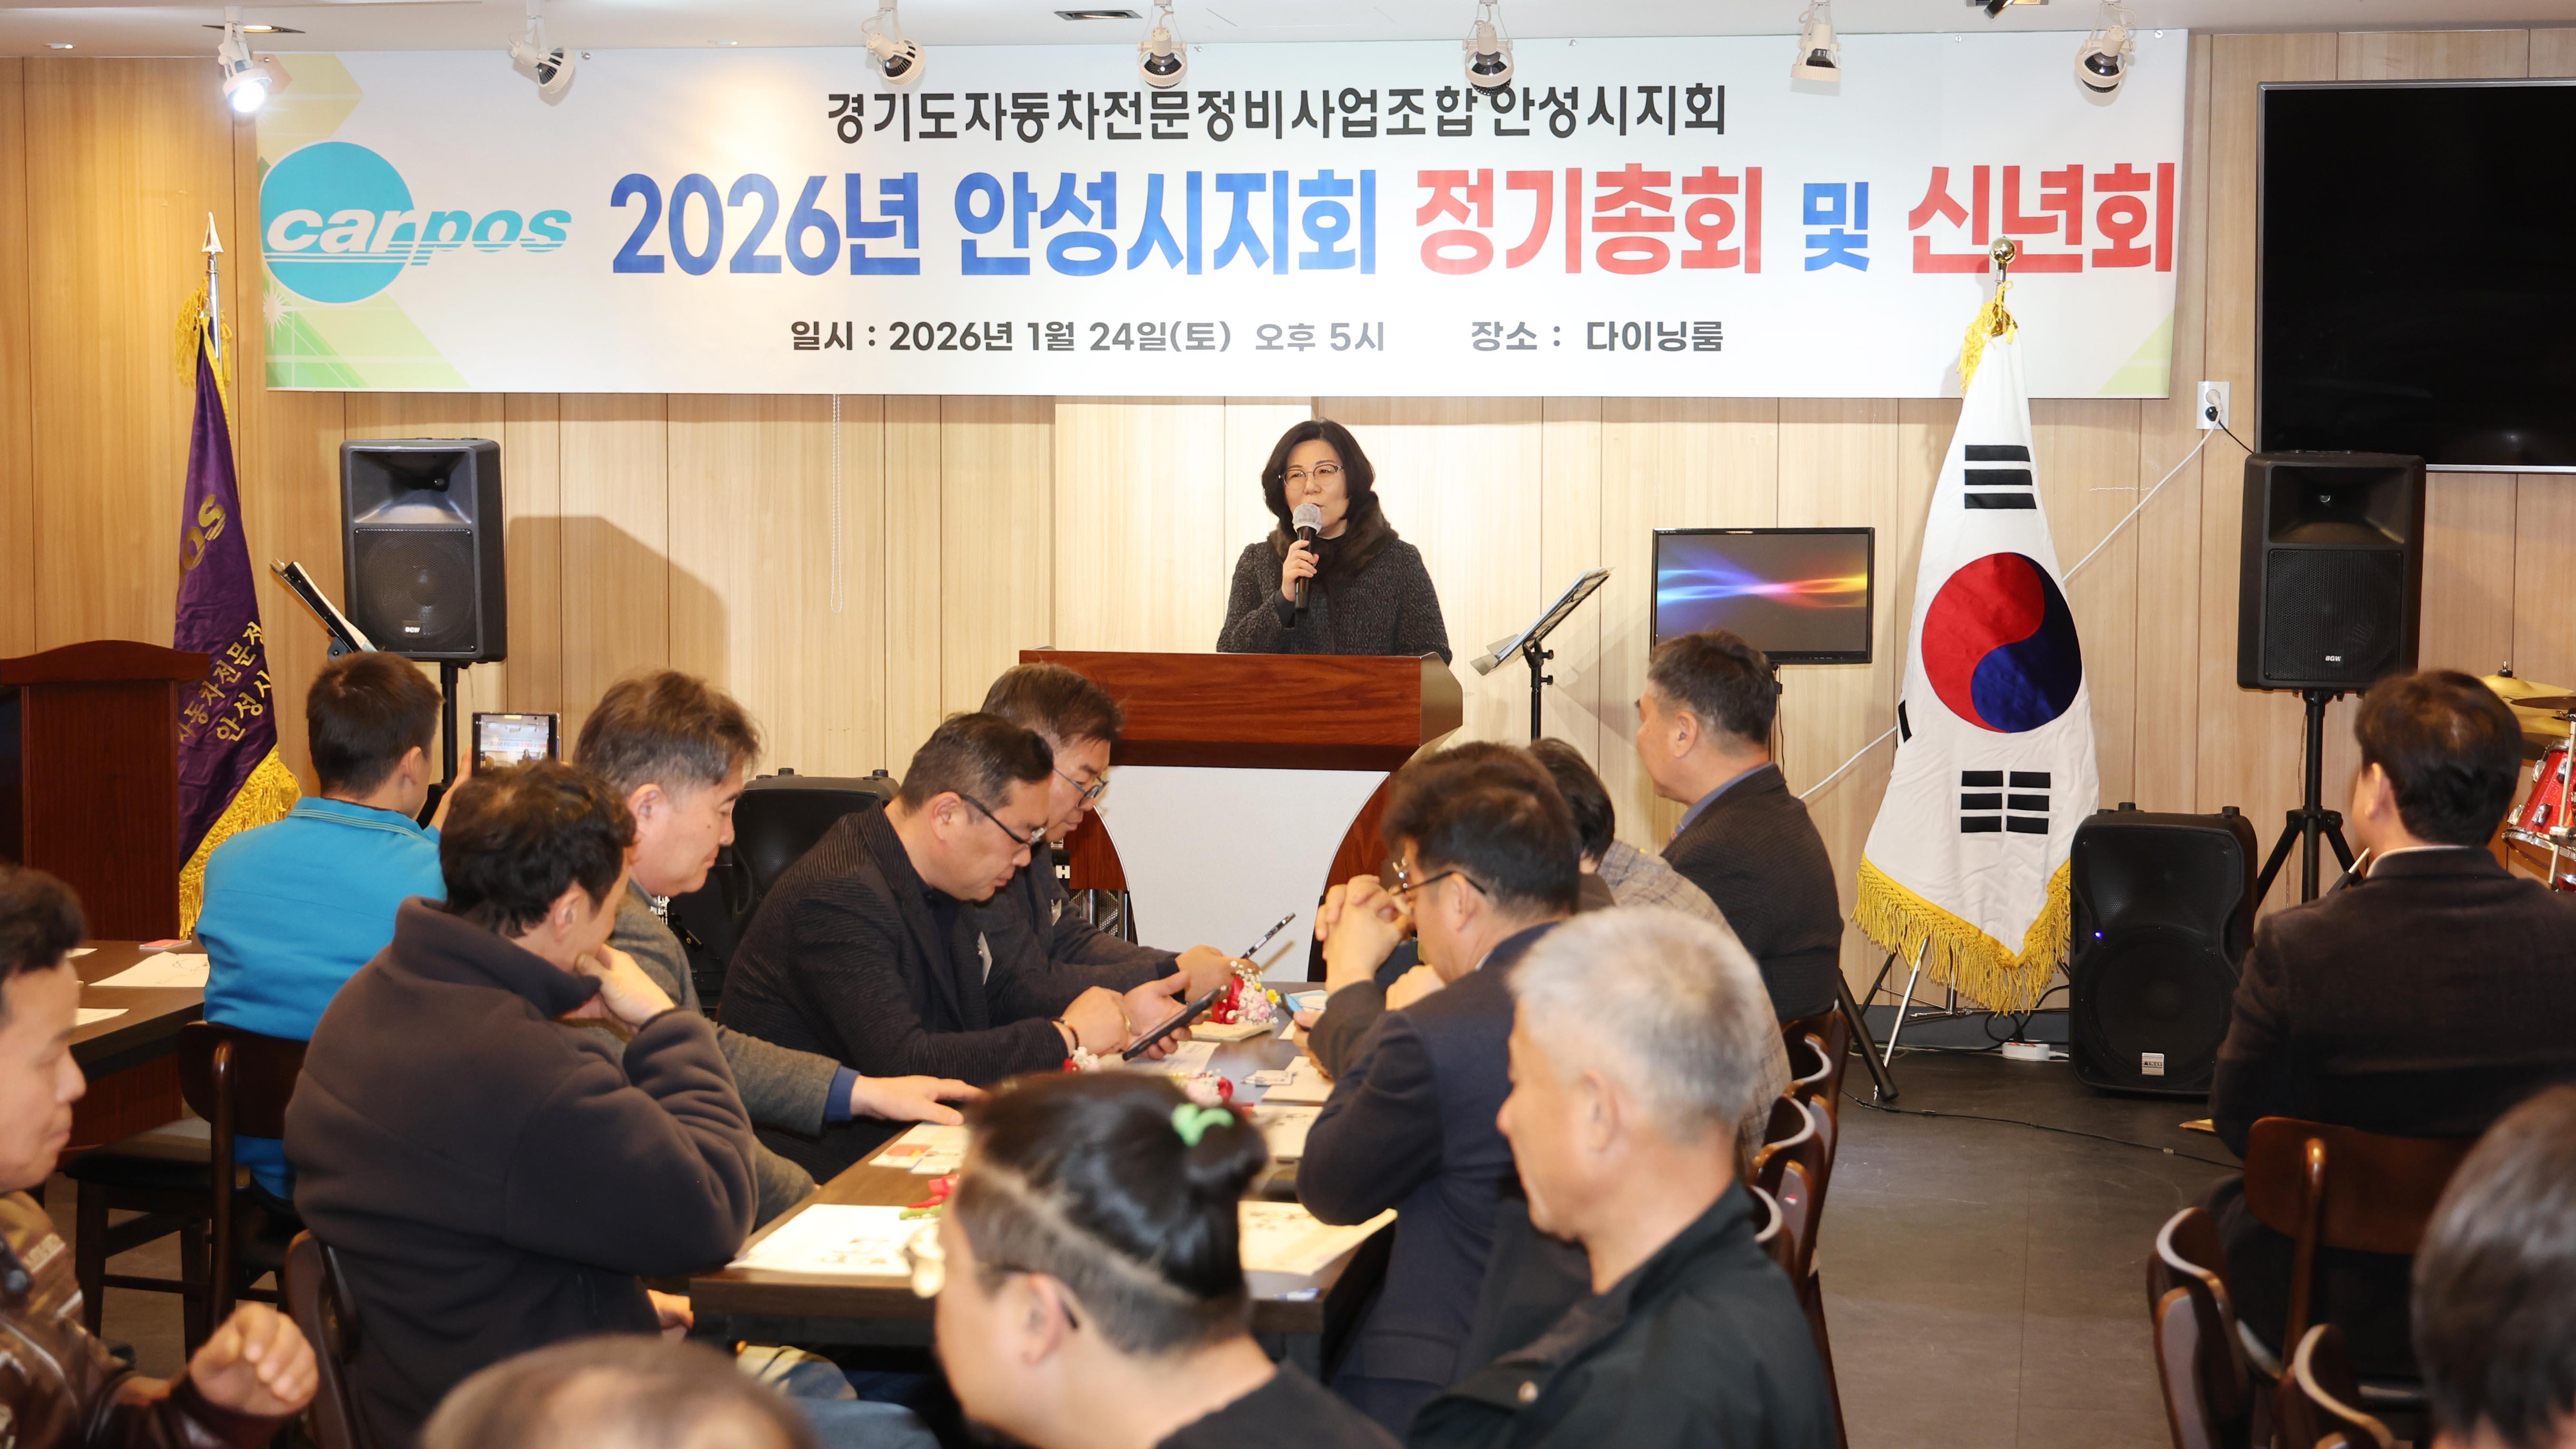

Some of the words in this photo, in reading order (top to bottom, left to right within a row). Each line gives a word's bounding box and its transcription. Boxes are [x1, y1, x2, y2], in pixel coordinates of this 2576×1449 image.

[266, 209, 572, 266] carpos
[610, 172, 920, 276] 2026년
[954, 169, 1376, 277] 안성시지회
[1416, 163, 1762, 275] 정기총회
[1803, 182, 1870, 272] 및
[1908, 163, 2175, 274] 신년회
[791, 321, 853, 351] 일시
[889, 321, 1013, 351] 2026년
[1027, 321, 1075, 351] 1월
[1089, 320, 1231, 352] 24일(토)
[1255, 323, 1316, 352] 오후
[1330, 321, 1385, 352] 5시
[1471, 321, 1538, 352] 장소
[1586, 321, 1724, 352] 다이닝룸
